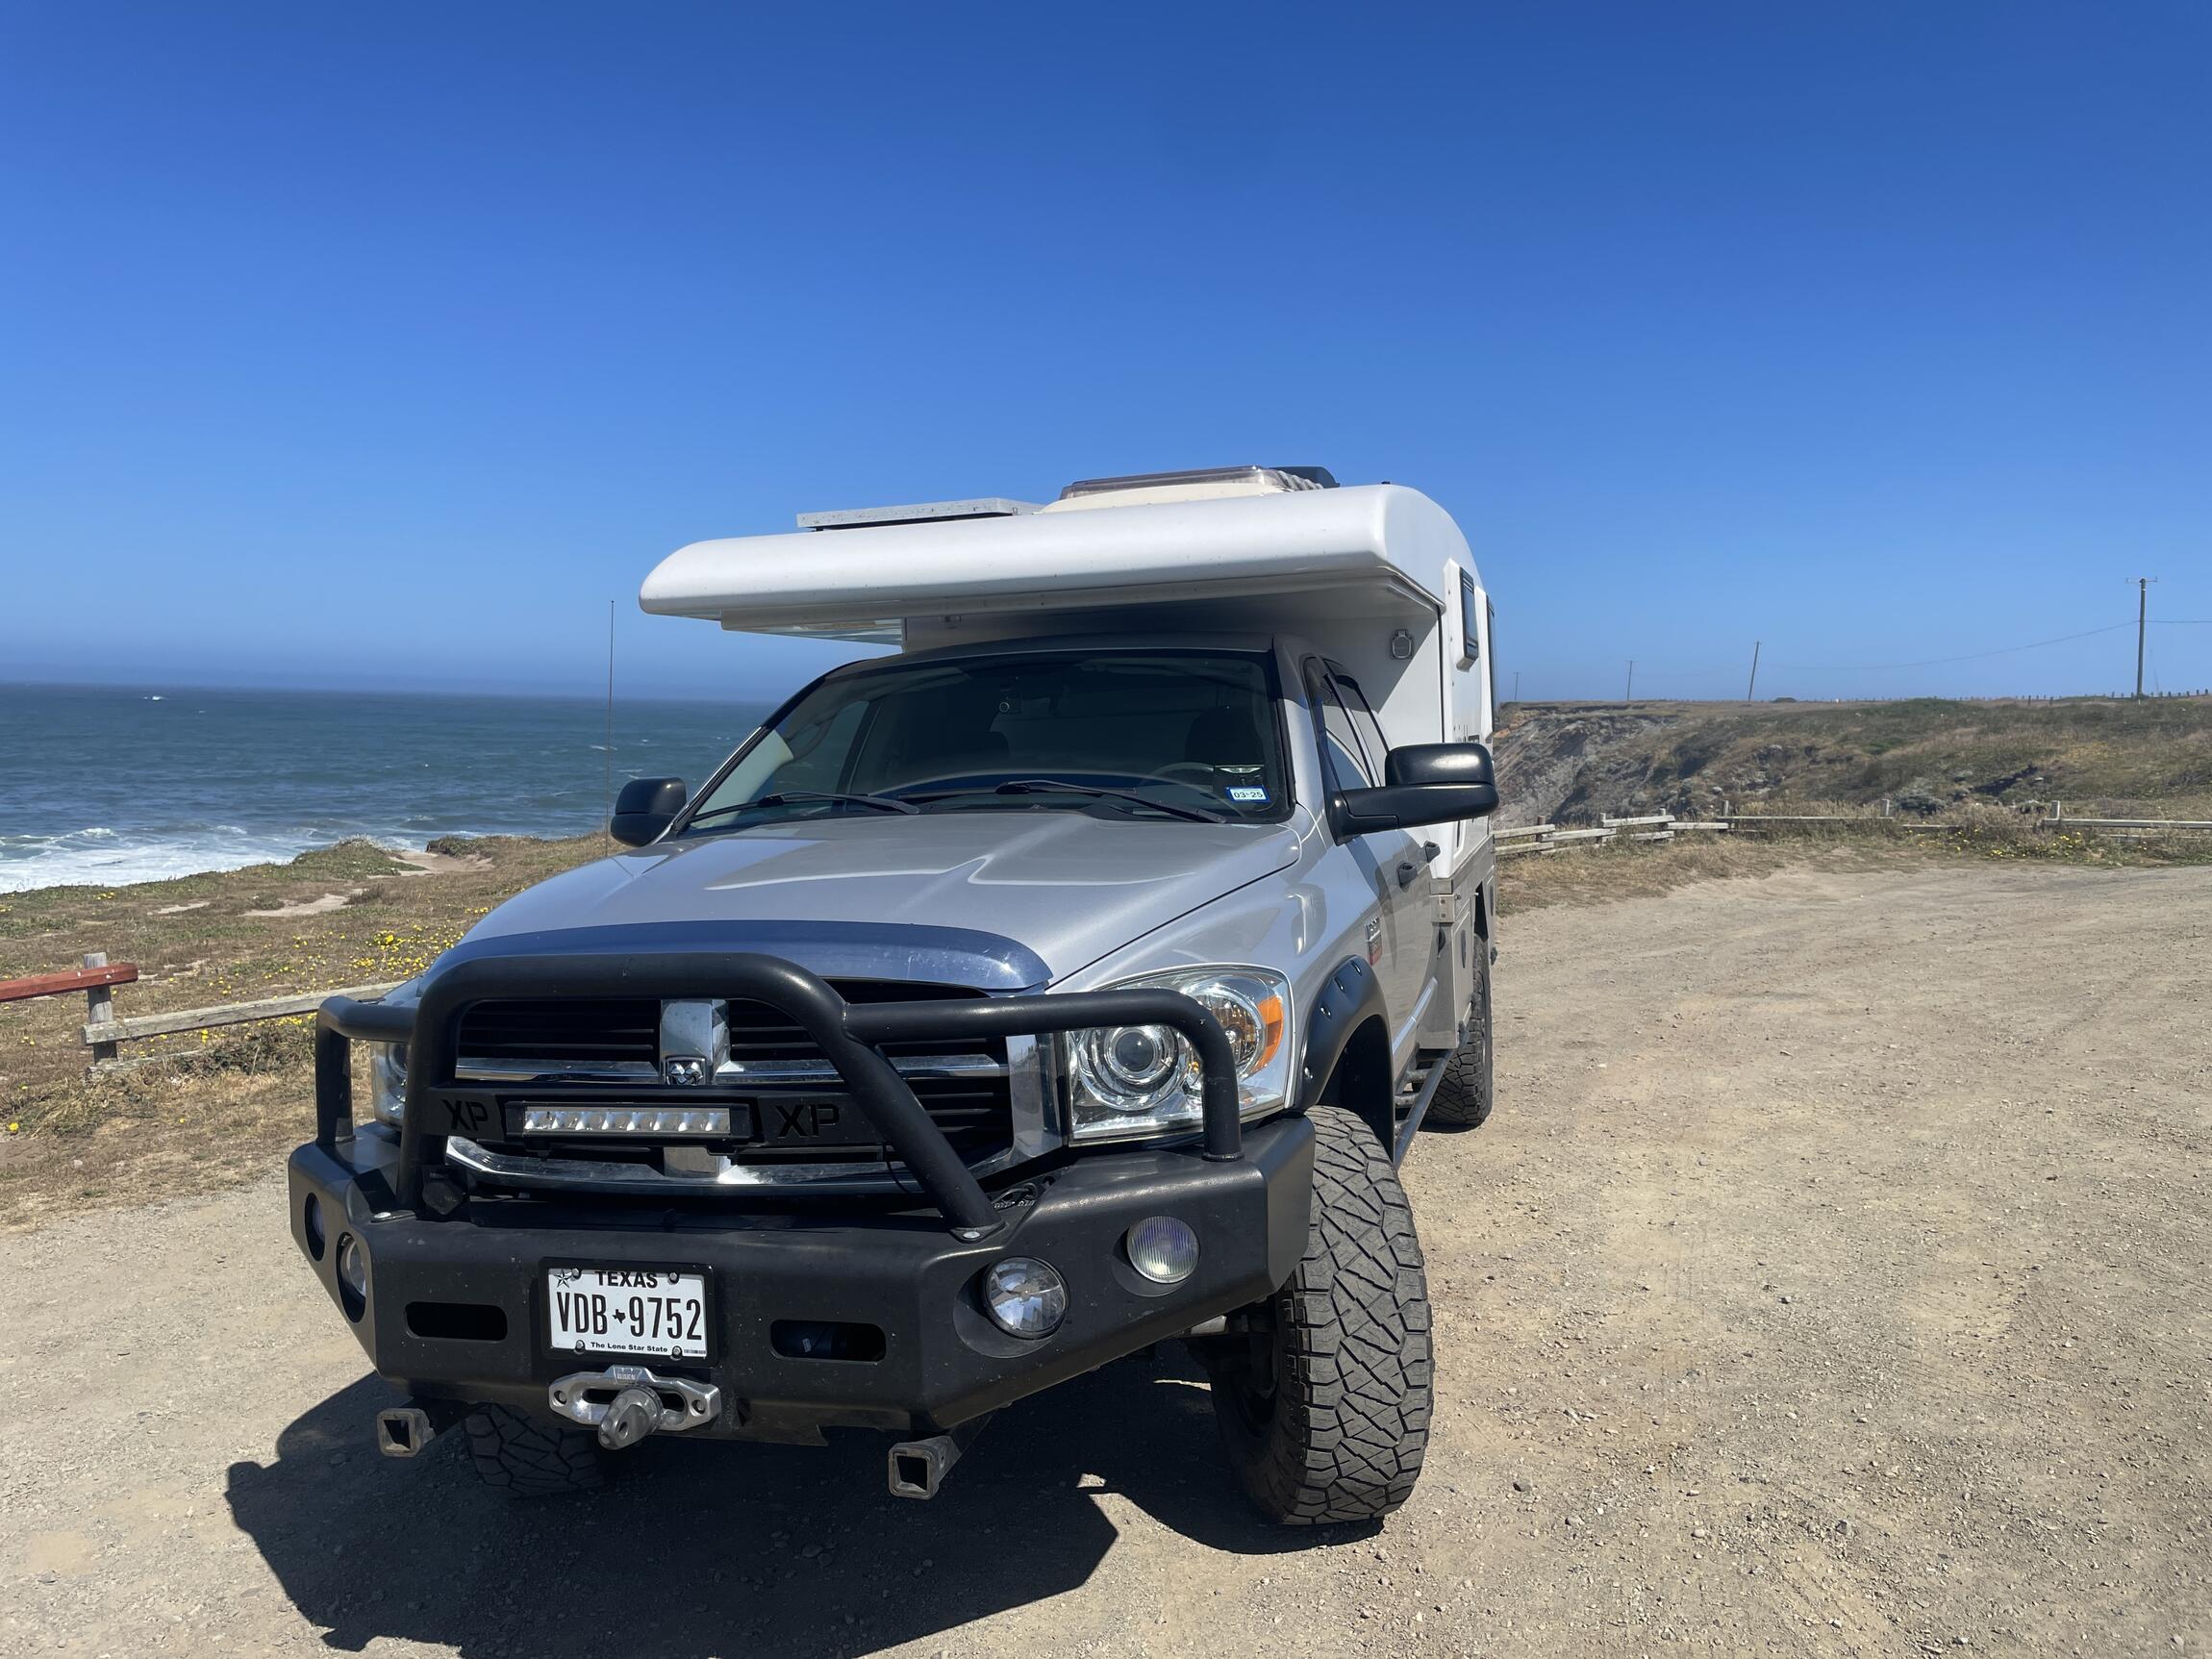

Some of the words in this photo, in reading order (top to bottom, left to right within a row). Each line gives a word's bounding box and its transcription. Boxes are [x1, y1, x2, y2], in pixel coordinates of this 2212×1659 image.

[441, 1099, 489, 1131] XP
[775, 1104, 840, 1136] XP
[594, 1270, 658, 1289] TEXAS
[556, 1292, 608, 1335] VDB
[629, 1295, 702, 1341] 9752
